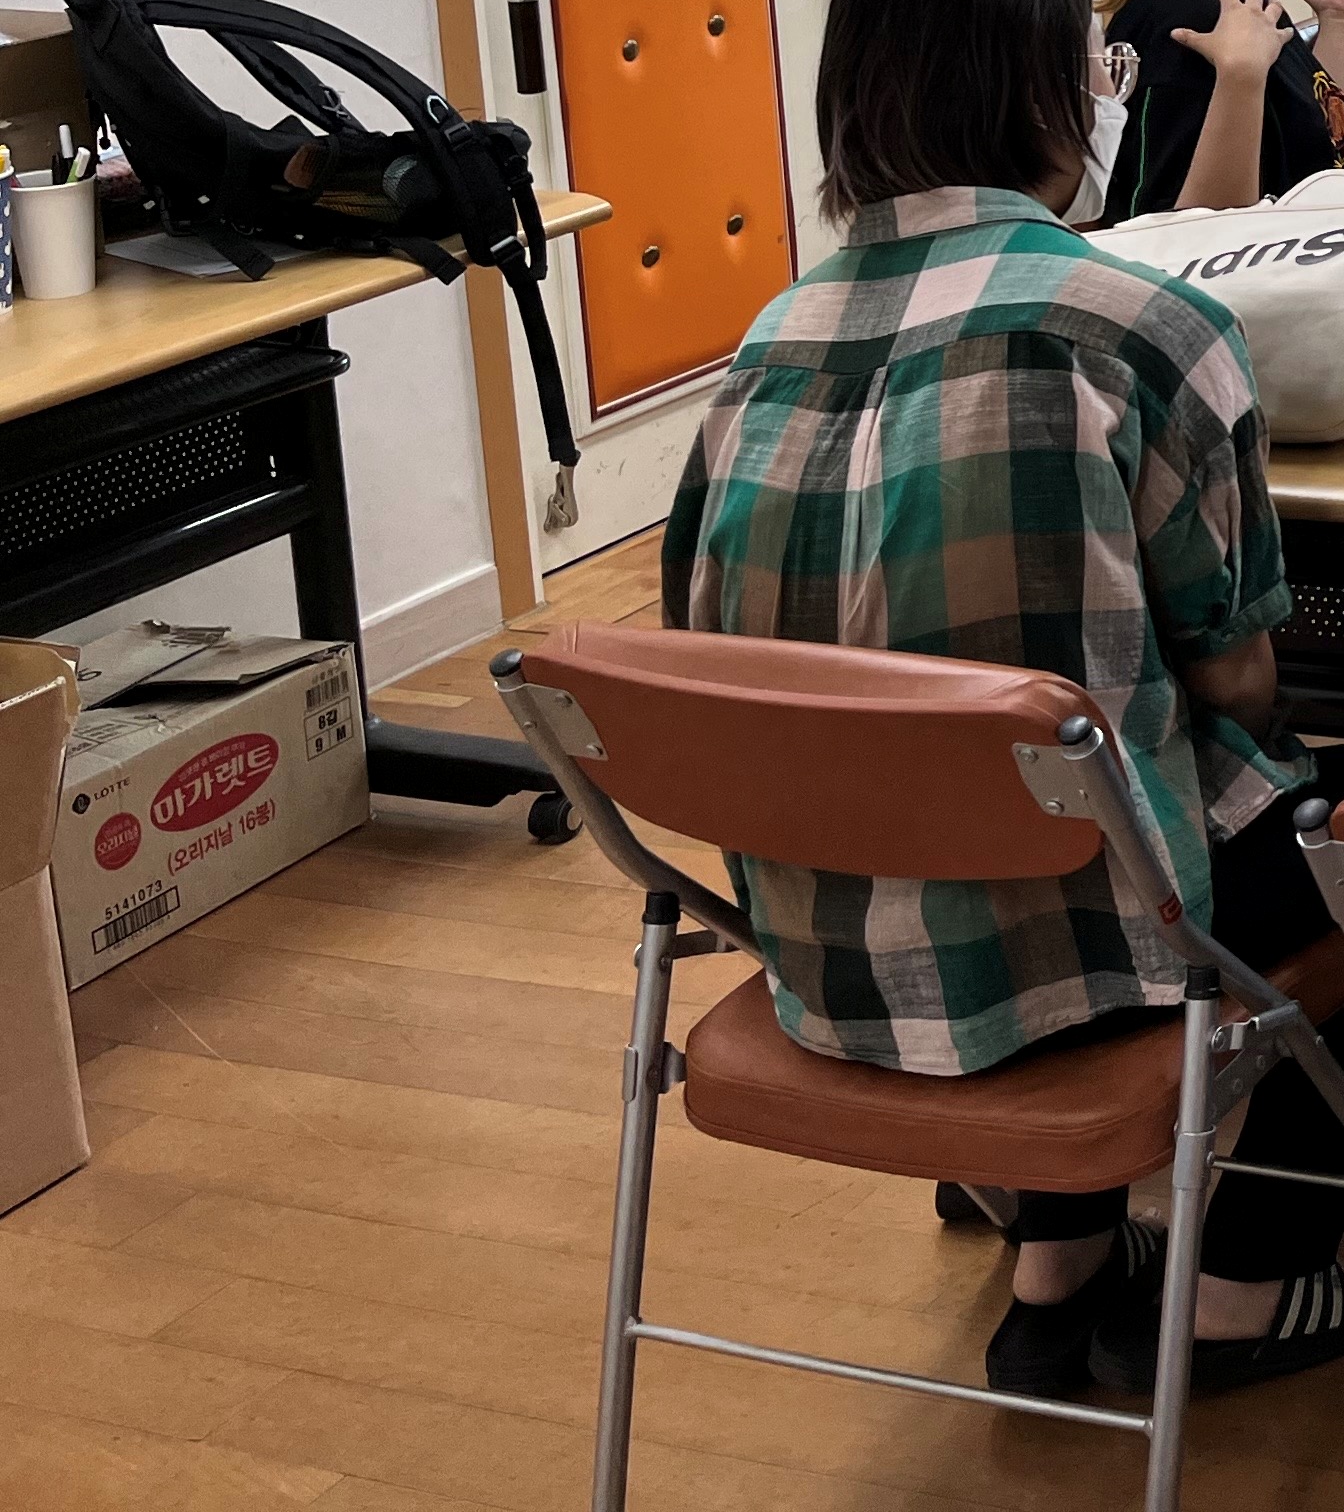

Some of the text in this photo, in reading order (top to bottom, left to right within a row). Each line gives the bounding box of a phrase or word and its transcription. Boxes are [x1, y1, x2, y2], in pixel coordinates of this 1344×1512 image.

[94, 776, 131, 802] LOTTE
[153, 743, 274, 825] 마가렛트
[104, 879, 163, 921] 5141073
